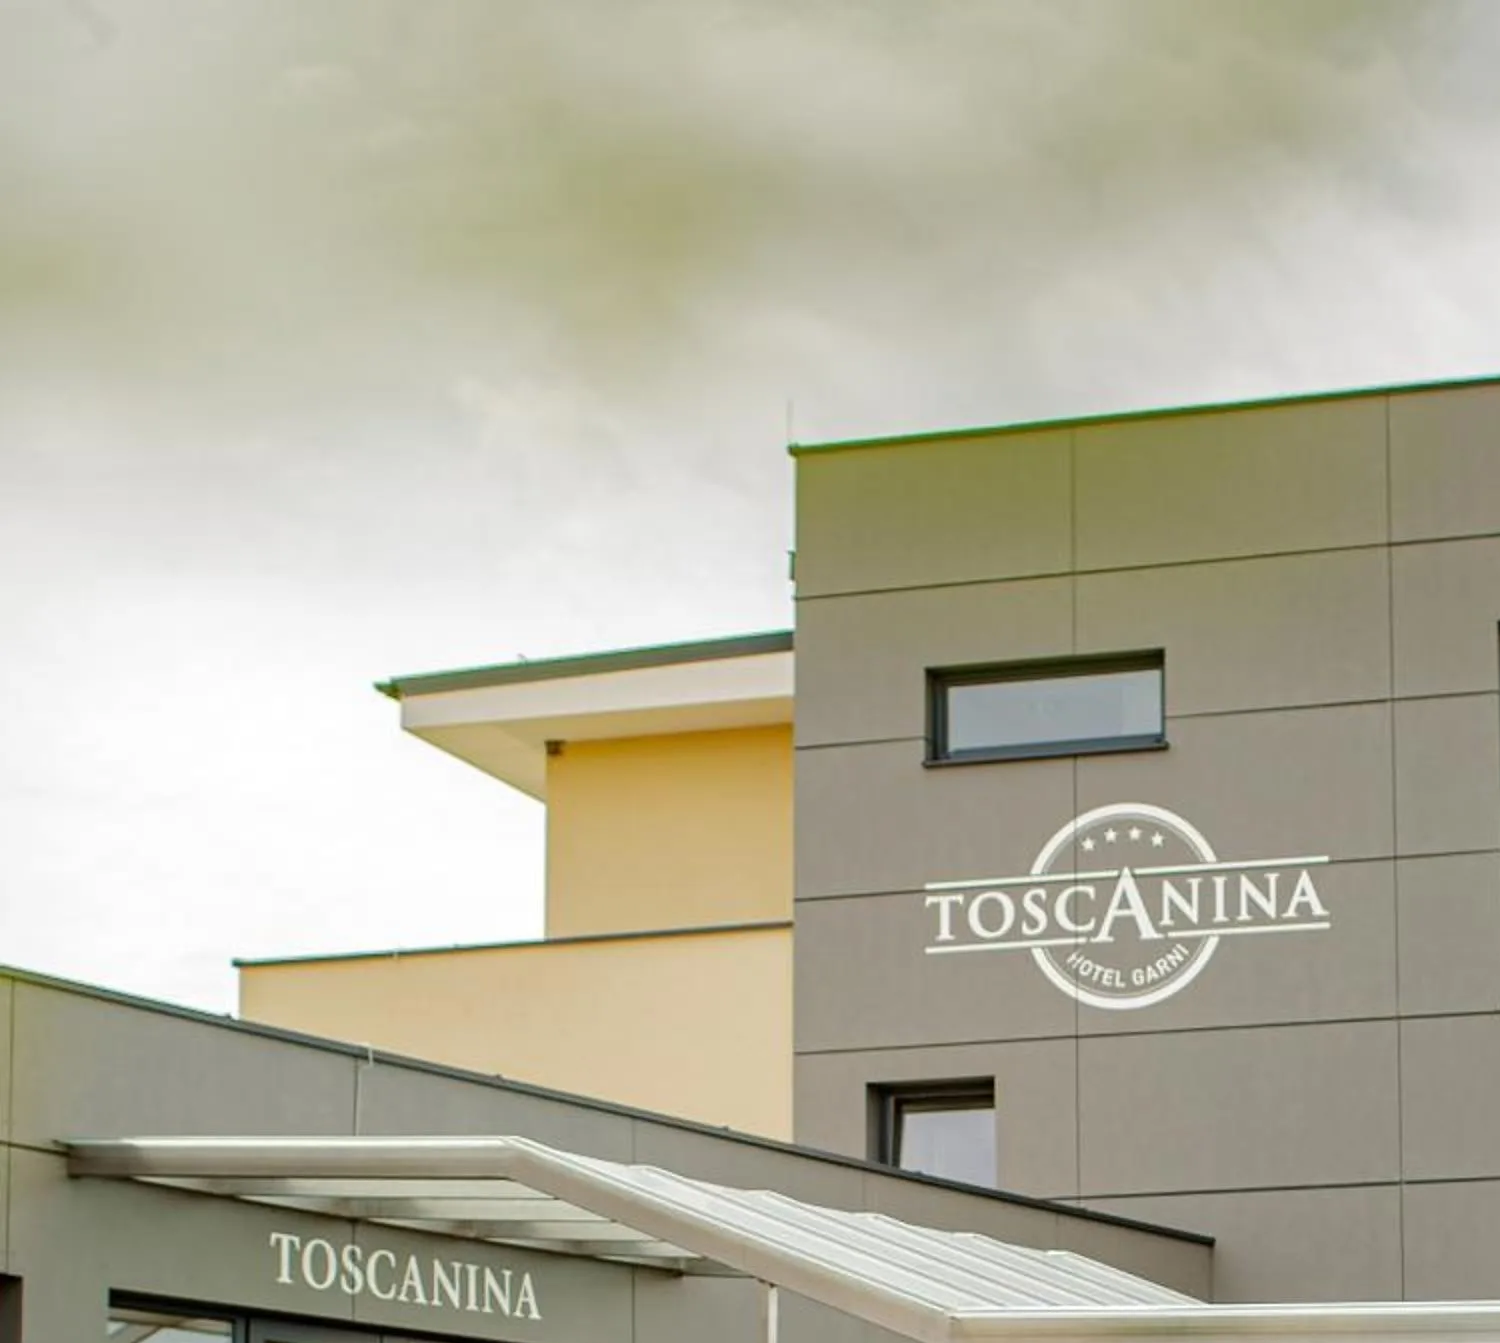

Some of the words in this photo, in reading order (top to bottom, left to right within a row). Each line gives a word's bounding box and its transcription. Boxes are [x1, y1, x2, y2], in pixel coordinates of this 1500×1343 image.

[925, 866, 1330, 943] TOSCANINA
[1066, 949, 1126, 988] HOTEL
[1131, 943, 1190, 986] GARNI
[269, 1231, 543, 1321] TOSCANINA
